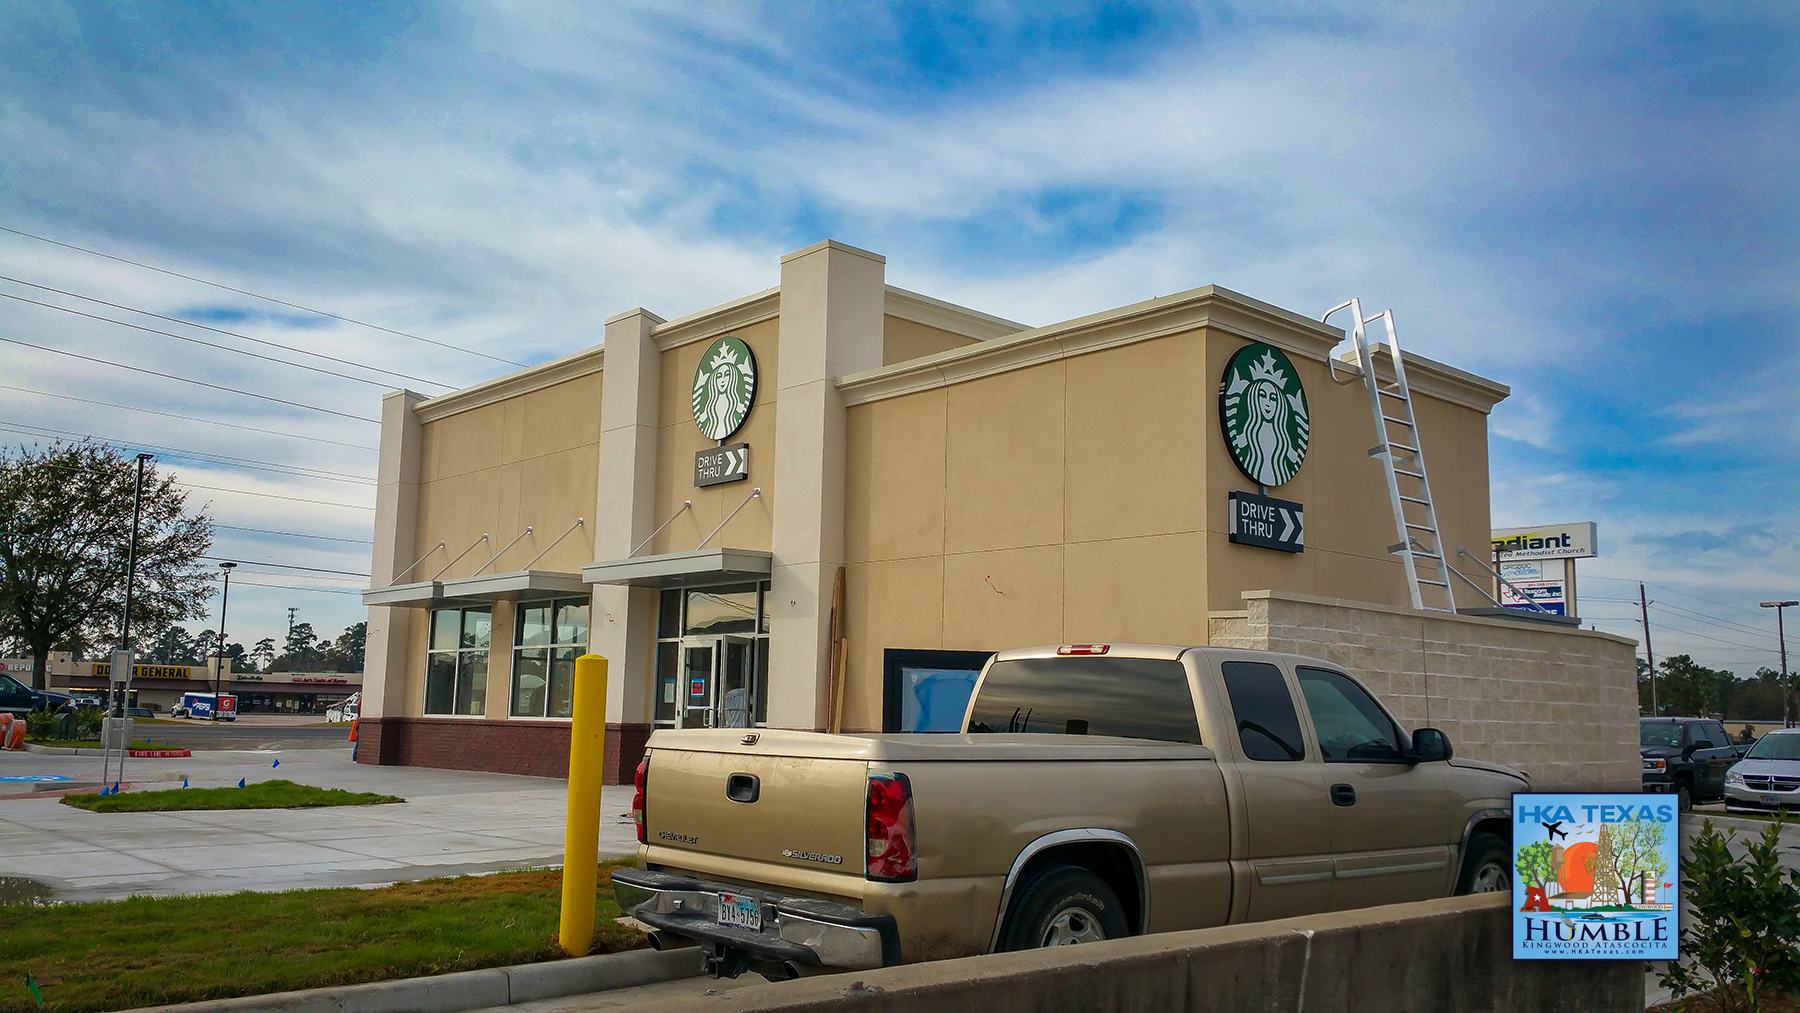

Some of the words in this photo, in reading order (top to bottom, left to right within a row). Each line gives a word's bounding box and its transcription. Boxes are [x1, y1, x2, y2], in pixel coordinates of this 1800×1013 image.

[698, 453, 723, 468] DRIVE
[698, 467, 720, 480] THRU
[1241, 501, 1275, 522] DRIVE
[1242, 518, 1273, 539] THRU
[1491, 532, 1571, 550] diant
[1515, 548, 1555, 557] Methodist
[1557, 547, 1586, 555] Church
[7, 663, 52, 672] REPUC
[96, 665, 138, 677] DOR
[141, 667, 188, 678] GENERAL
[223, 699, 230, 707] G
[658, 830, 699, 844] CHEVROLET
[791, 850, 842, 865] SILVERADO
